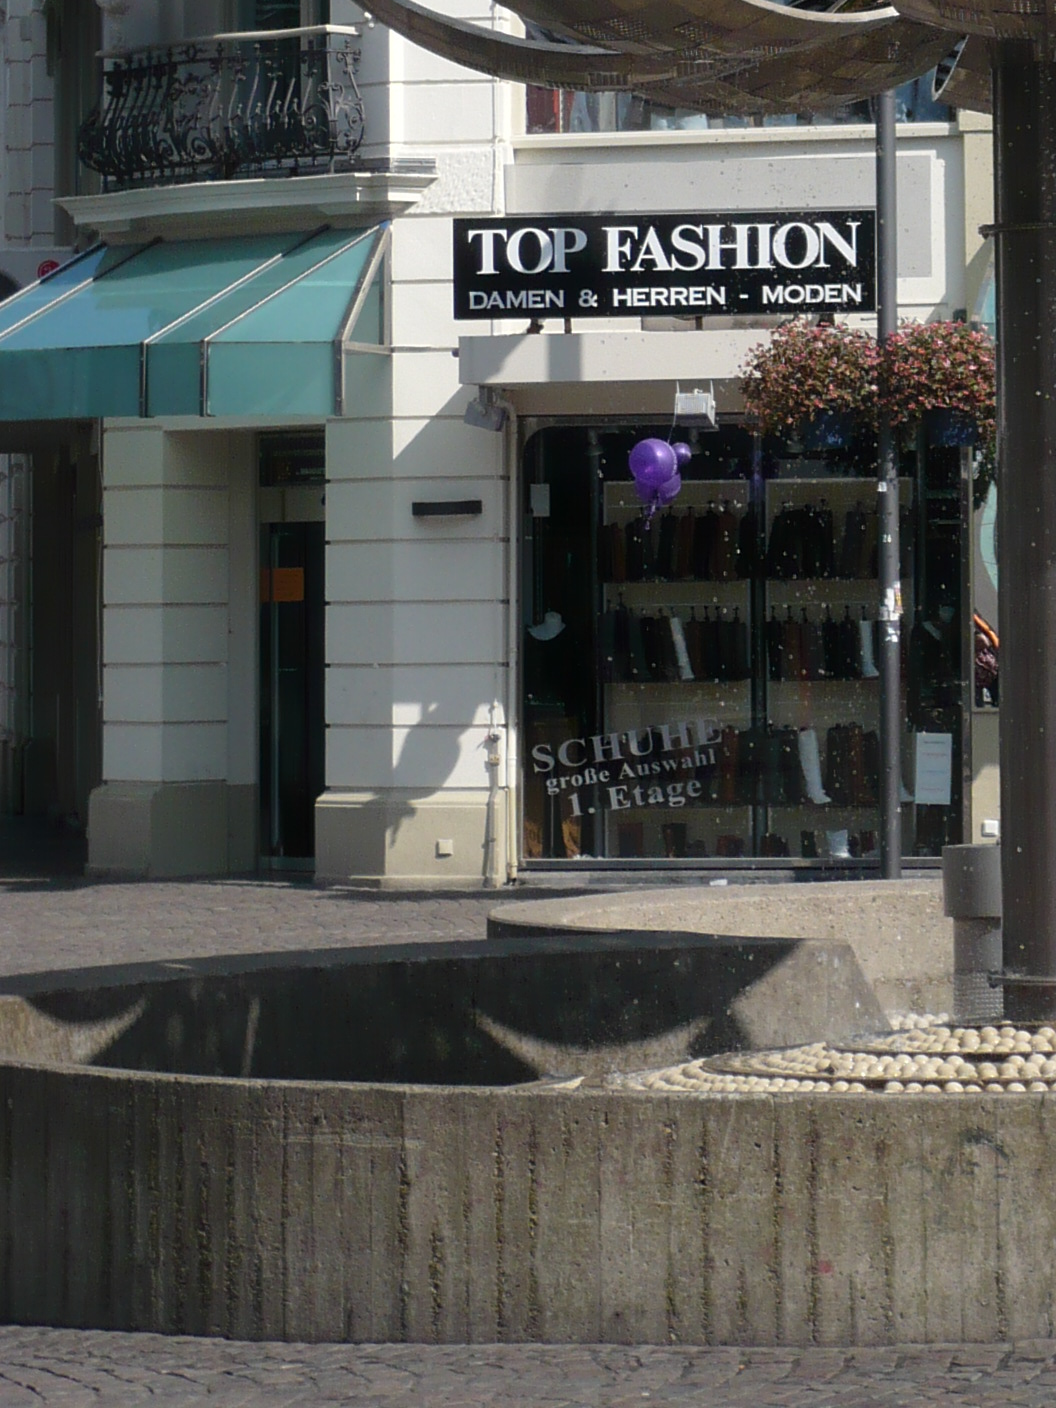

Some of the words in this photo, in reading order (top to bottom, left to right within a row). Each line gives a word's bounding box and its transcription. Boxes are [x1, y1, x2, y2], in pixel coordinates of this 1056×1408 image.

[467, 227, 588, 274] TOP
[601, 221, 862, 272] FASHION
[468, 289, 564, 310] DAMEN
[577, 289, 598, 308] &
[613, 286, 726, 307] HERREN
[761, 283, 863, 304] MODEN
[531, 717, 722, 773] SCHUHE
[545, 767, 610, 795] große
[618, 748, 717, 779] Auswahl
[568, 793, 596, 817] 1.
[607, 779, 702, 810] Etage
